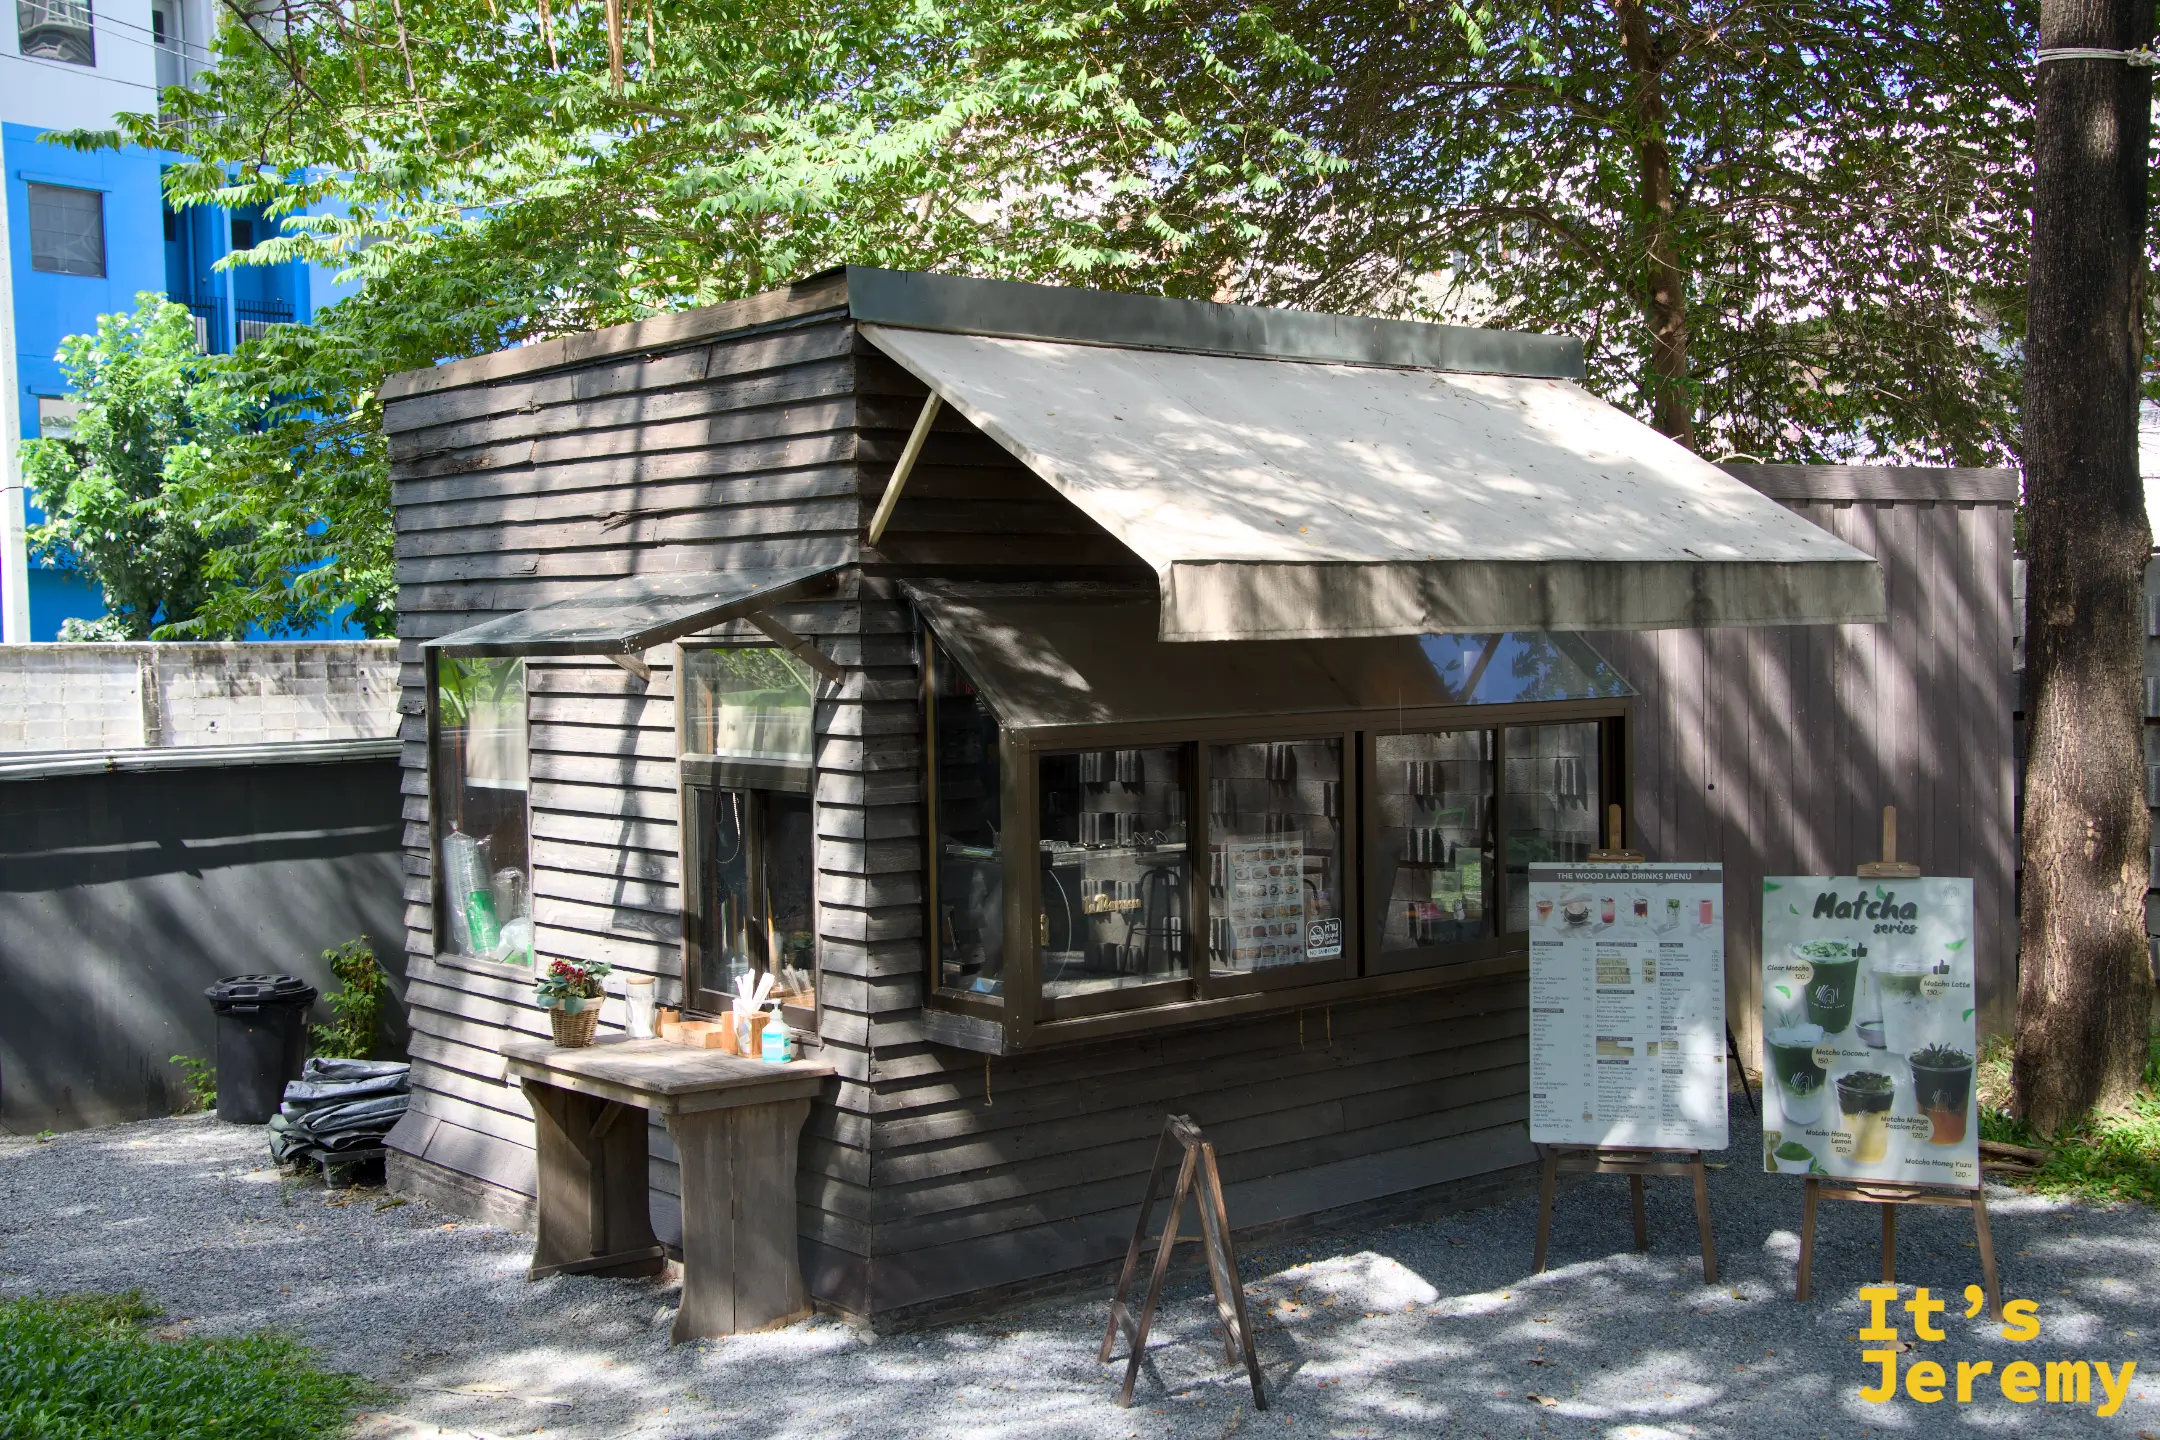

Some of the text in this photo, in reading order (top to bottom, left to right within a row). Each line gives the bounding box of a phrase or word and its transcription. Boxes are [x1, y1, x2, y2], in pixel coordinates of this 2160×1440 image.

[1812, 891, 1918, 920] Matcha
[1873, 921, 1918, 934] series
[1906, 1117, 1929, 1125] Mango
[1830, 1131, 1852, 1139] Honey
[1932, 1160, 1954, 1169] Honey
